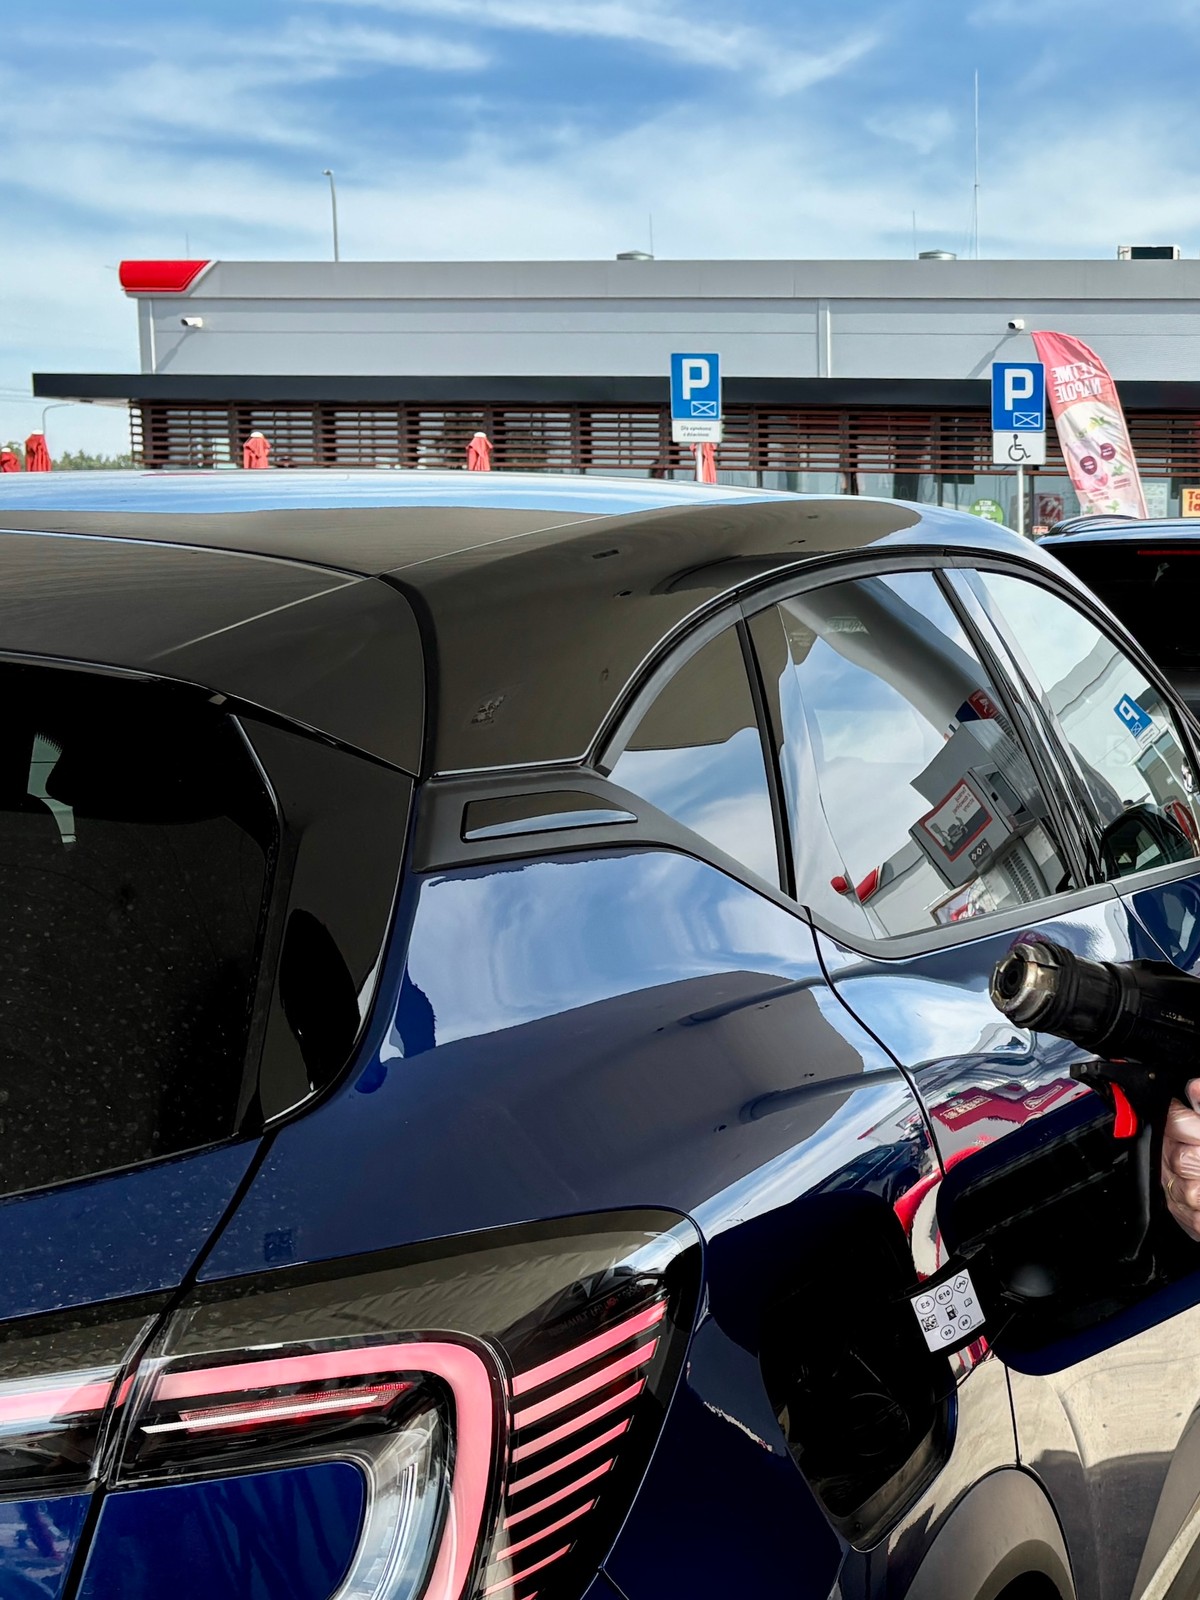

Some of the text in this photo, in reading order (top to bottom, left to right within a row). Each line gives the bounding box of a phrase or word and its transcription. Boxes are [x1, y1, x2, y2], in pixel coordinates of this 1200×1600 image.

[682, 358, 710, 400] P
[1004, 368, 1034, 411] P
[938, 1289, 951, 1300] E10
